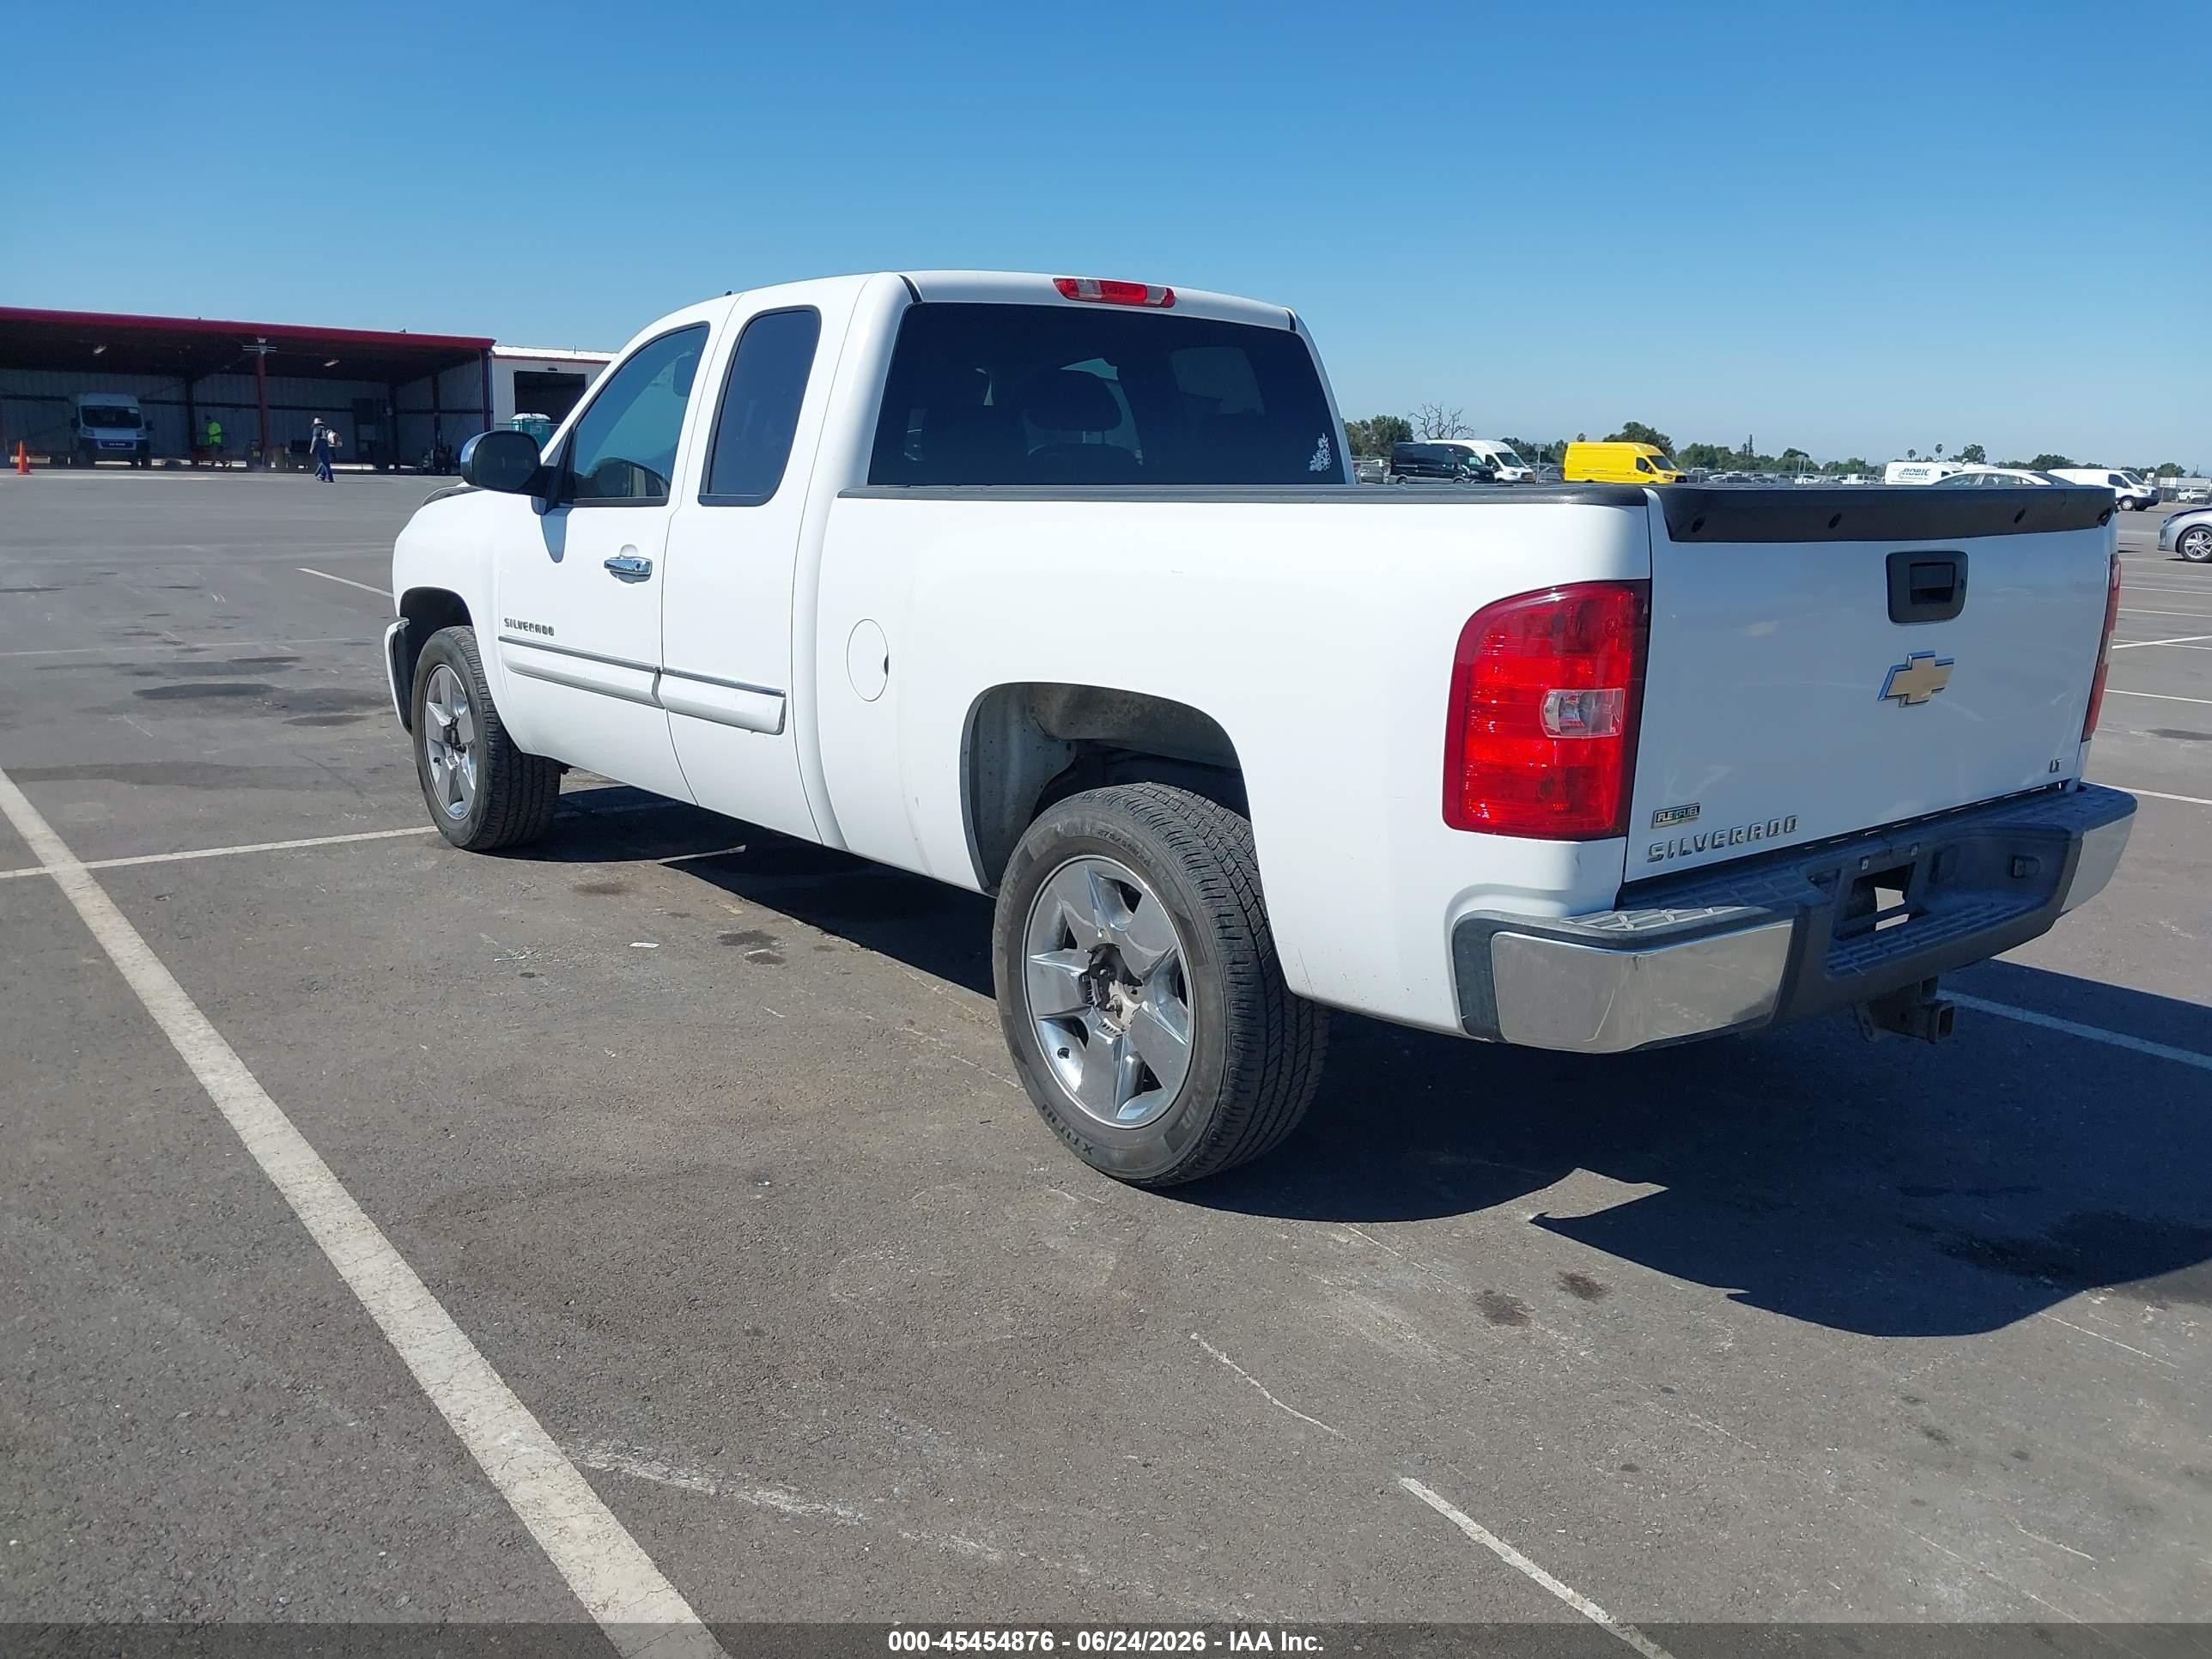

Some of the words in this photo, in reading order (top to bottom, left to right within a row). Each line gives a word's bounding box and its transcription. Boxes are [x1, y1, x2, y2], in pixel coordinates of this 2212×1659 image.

[503, 617, 555, 636] SILVERADO
[2048, 757, 2063, 774] LT
[1647, 814, 1801, 863] SILVERADO
